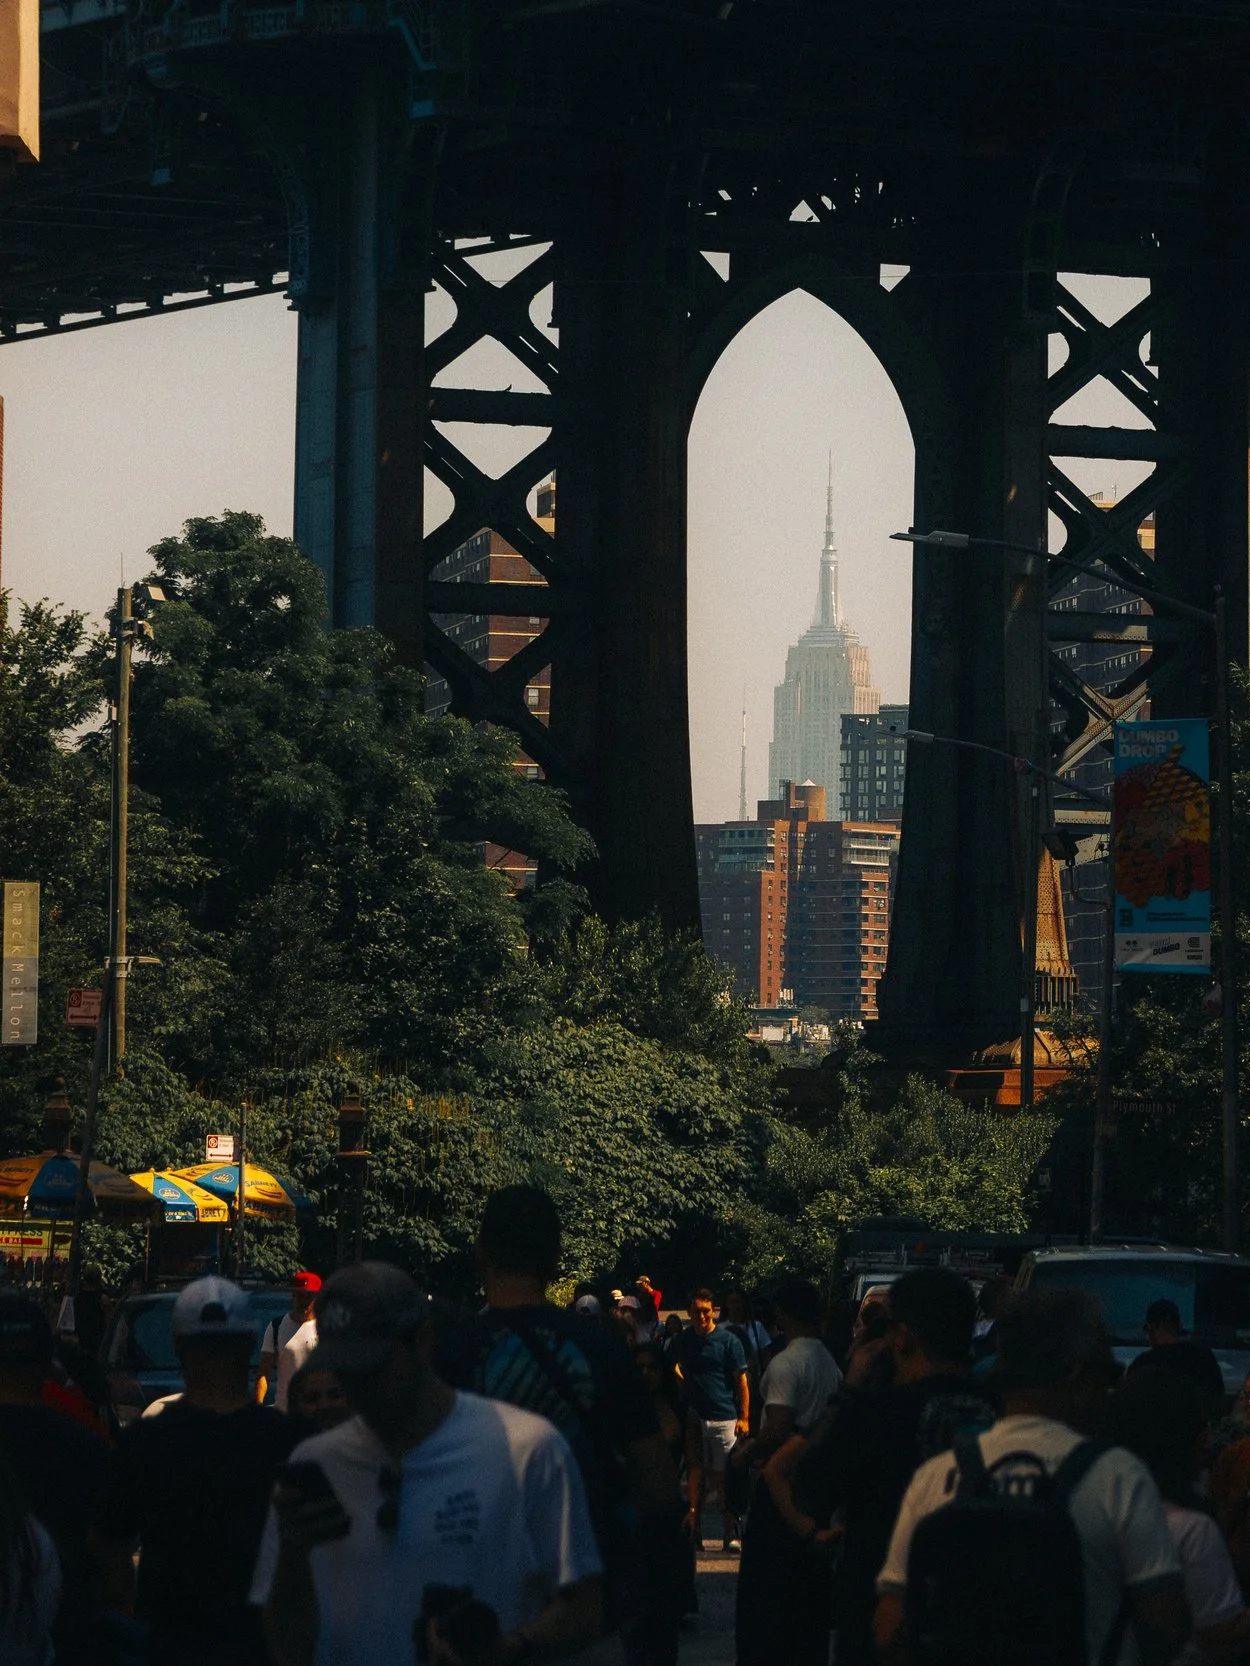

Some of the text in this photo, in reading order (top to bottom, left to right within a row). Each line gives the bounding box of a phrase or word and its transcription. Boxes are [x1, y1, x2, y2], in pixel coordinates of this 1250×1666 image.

[1118, 729, 1179, 743] DUMBO
[1118, 743, 1167, 758] DROP
[9, 889, 26, 1040] Smack Mellon
[1112, 1100, 1177, 1115] Plymouth St
